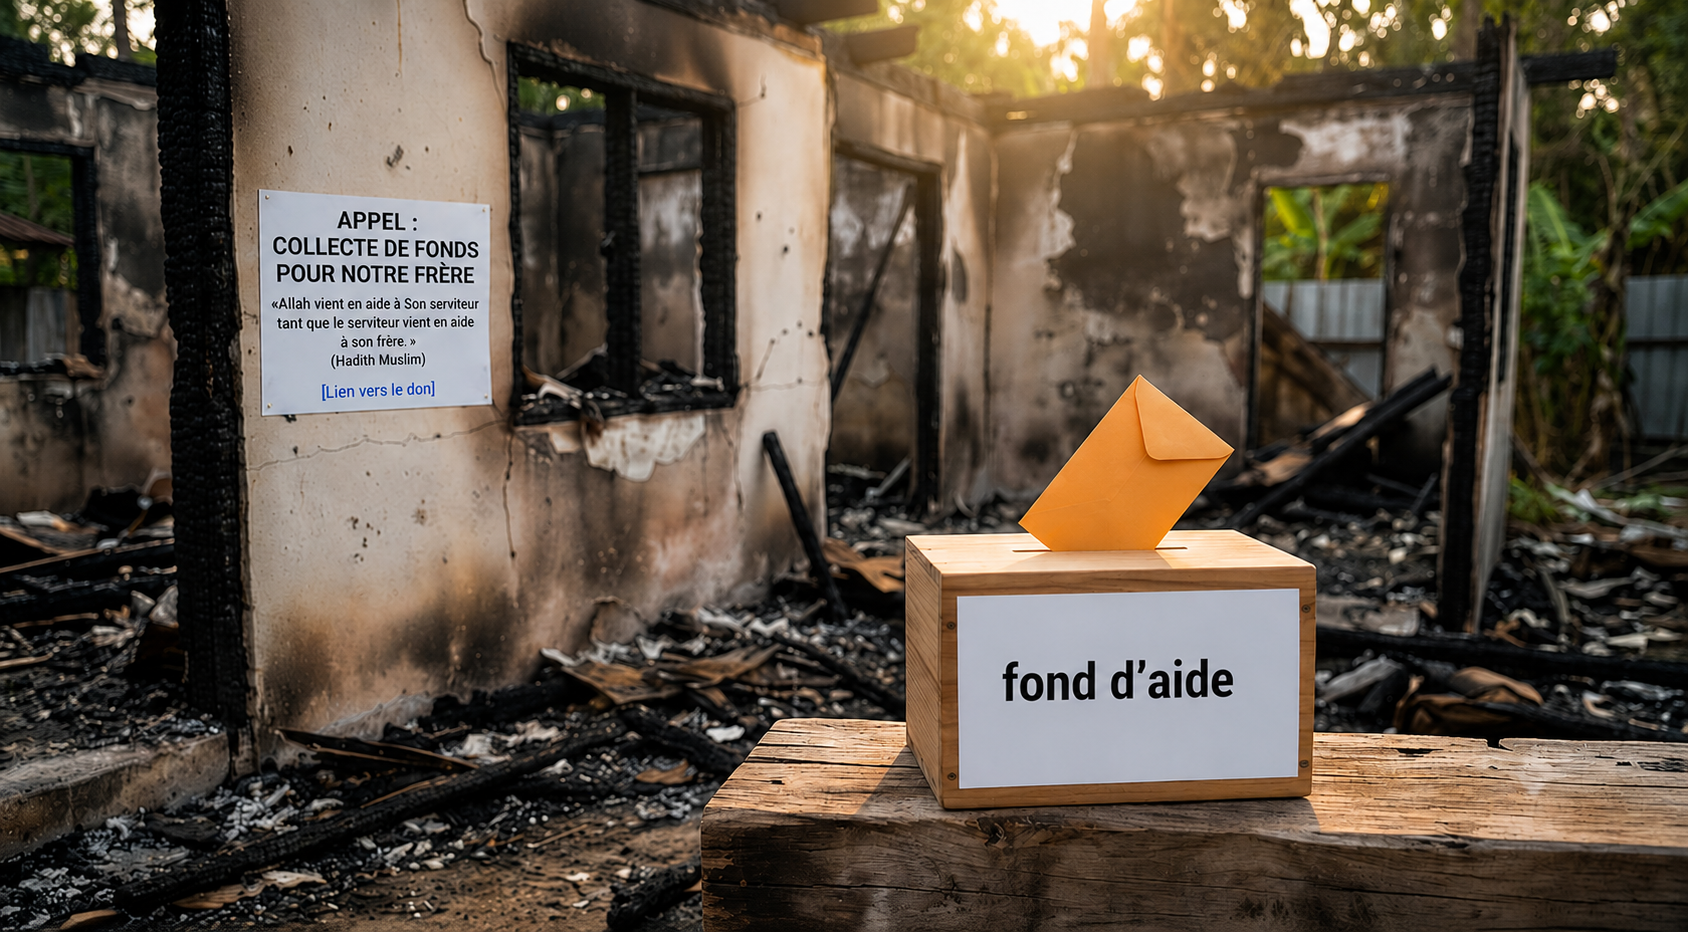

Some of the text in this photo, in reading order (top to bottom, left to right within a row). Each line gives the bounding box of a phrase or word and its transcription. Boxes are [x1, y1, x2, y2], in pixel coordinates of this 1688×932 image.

[337, 211, 418, 232] APPEL :
[273, 236, 478, 258] COLLECTE DE FONDS
[277, 262, 474, 283] POUR NOTRE FRÈRE
[271, 297, 479, 309] «Allah vient en aide à Son serviteur
[277, 316, 474, 332] tant que le serviteur vient en aide
[341, 335, 416, 348] à son frère. »
[331, 353, 425, 369] (Hadith Muslim)
[322, 381, 435, 401] [Lien vers le don]
[1003, 659, 1233, 701] fond d’aide
